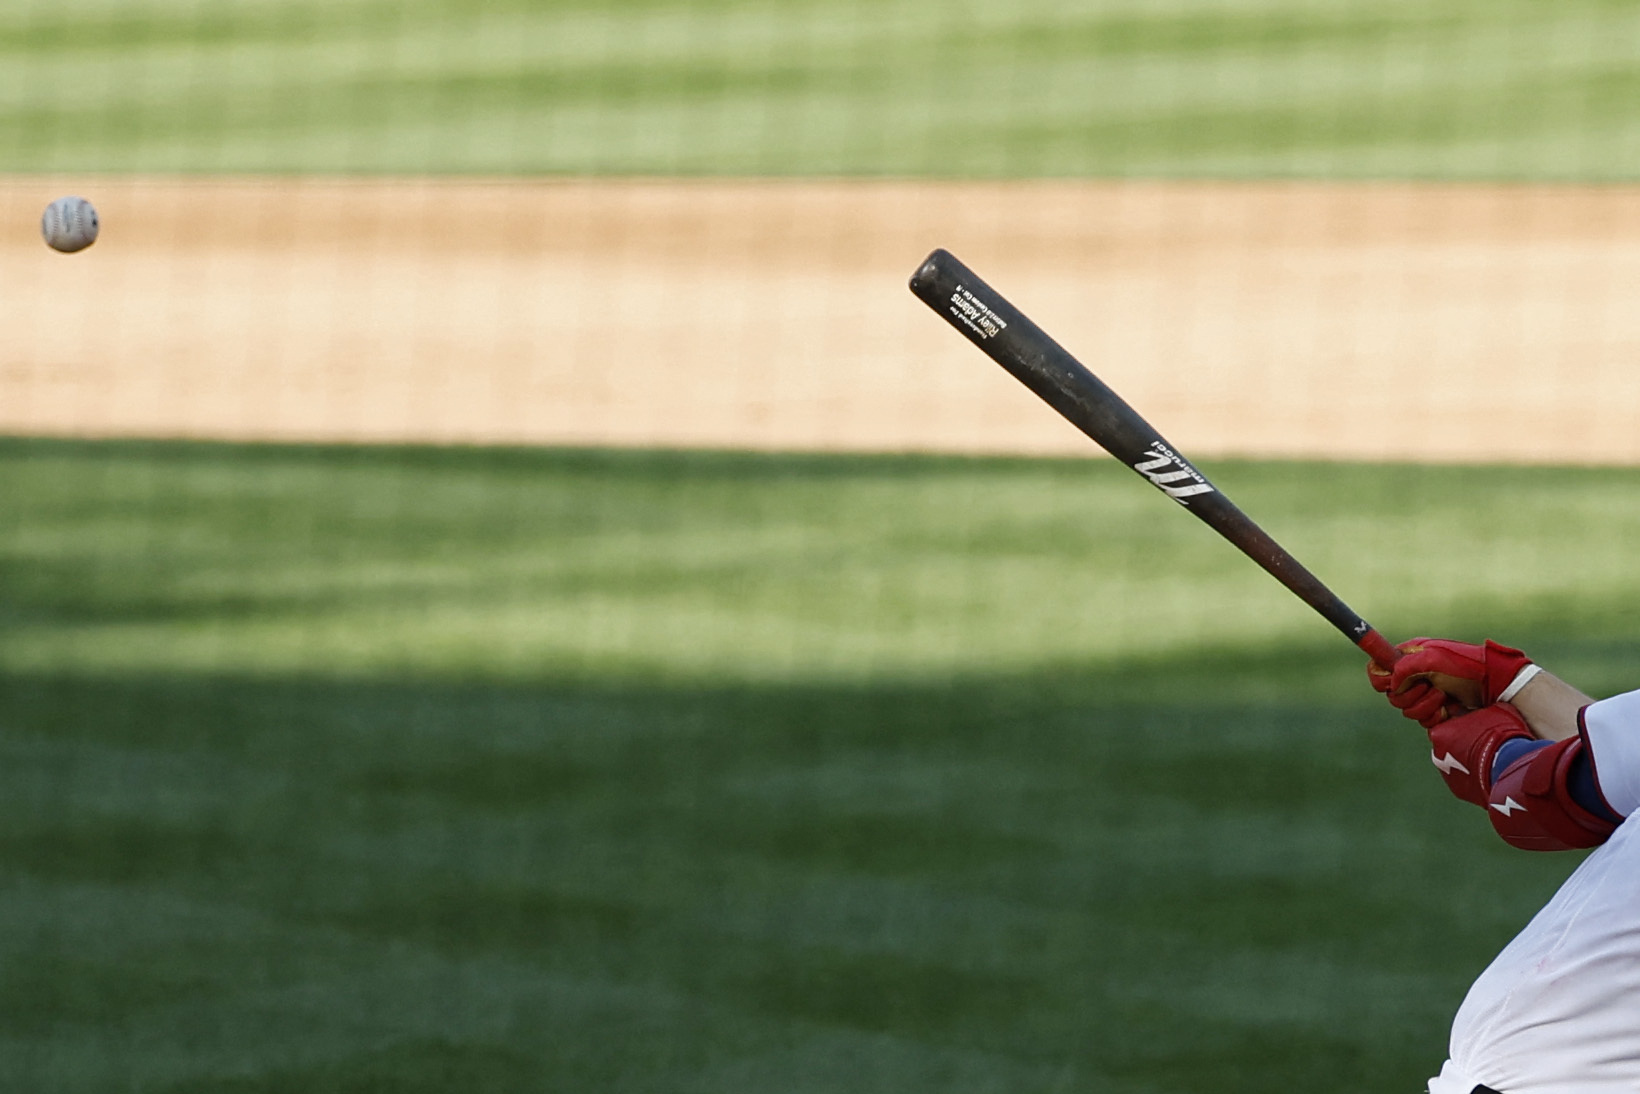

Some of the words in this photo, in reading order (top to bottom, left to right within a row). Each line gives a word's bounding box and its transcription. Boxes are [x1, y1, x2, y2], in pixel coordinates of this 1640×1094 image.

[951, 293, 980, 320] Adams
[978, 315, 999, 337] Riley
[1150, 441, 1204, 483] marucci
